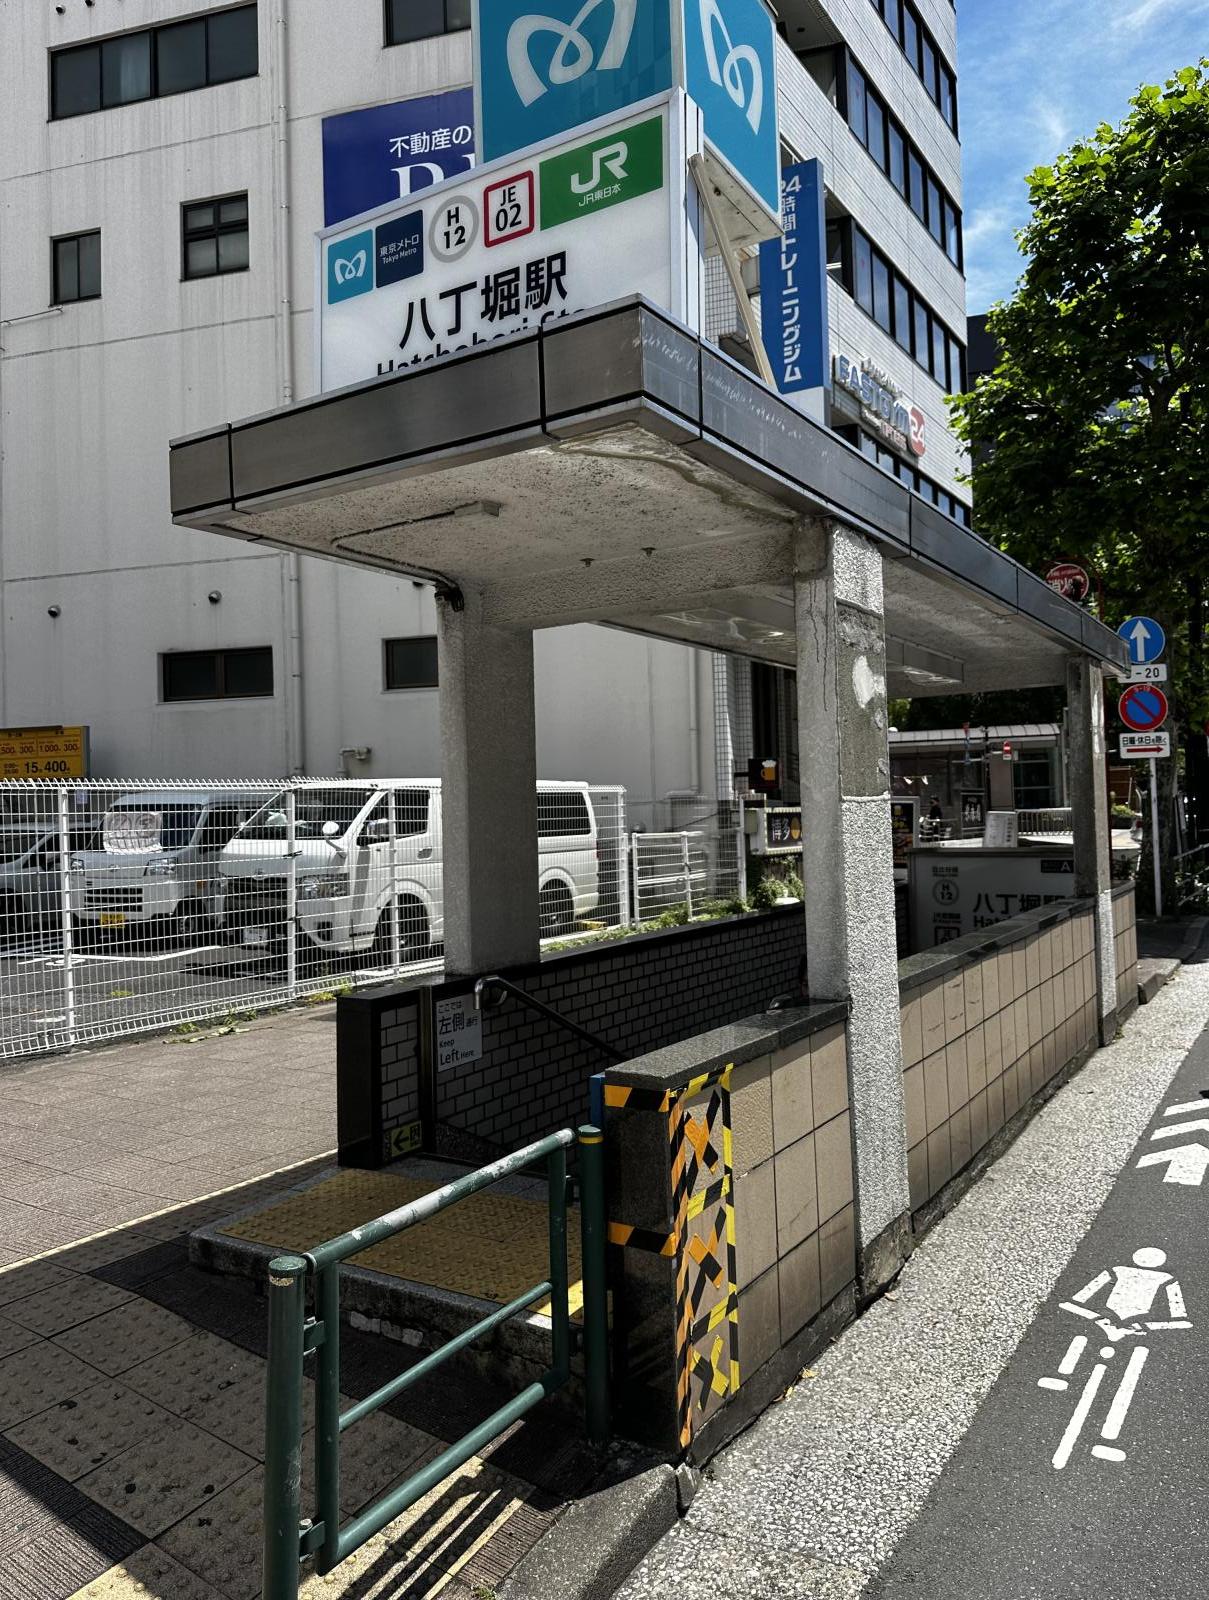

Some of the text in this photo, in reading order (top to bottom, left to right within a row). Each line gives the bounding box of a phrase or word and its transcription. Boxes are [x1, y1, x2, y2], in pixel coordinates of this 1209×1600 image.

[389, 125, 472, 158] 不動産の
[570, 141, 629, 194] JR
[500, 185, 516, 205] JE
[578, 184, 622, 207] JR東日本
[447, 206, 460, 226] H
[495, 202, 522, 232] 02
[379, 234, 419, 257] 東京メトロ
[443, 226, 466, 250] 12
[382, 247, 417, 265] Tokyo Metro
[399, 250, 568, 350] 八丁堀駅
[941, 891, 953, 900] 12
[440, 1039, 455, 1048] Keep
[440, 1049, 474, 1065] Left Here
